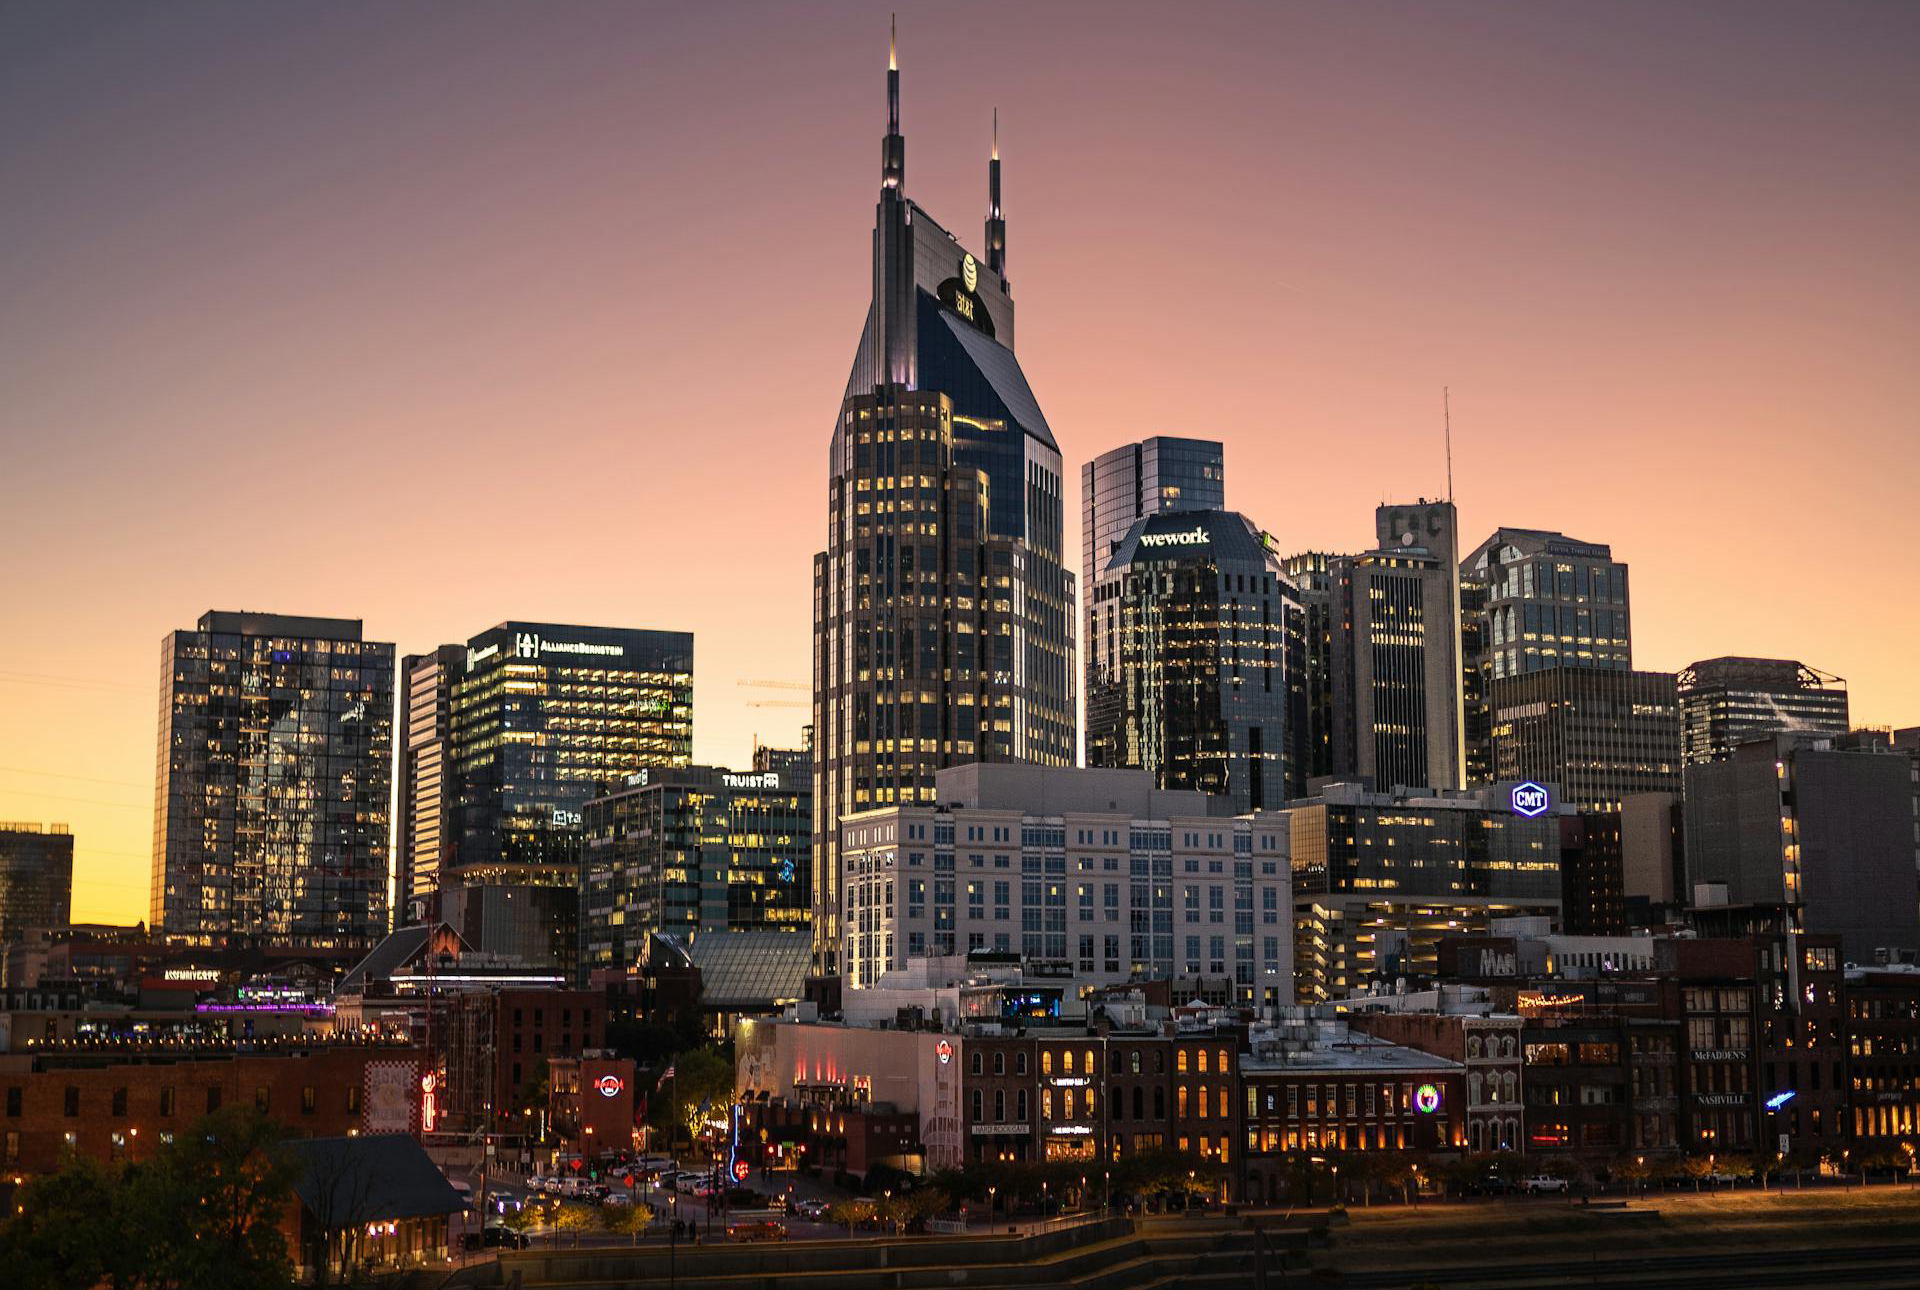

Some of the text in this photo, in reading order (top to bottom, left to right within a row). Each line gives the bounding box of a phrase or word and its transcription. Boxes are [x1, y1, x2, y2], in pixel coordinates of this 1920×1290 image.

[956, 290, 974, 321] at&t
[1140, 526, 1211, 548] wework
[722, 774, 763, 788] TRUIST
[1517, 791, 1543, 807] CMT
[1695, 1051, 1747, 1060] McFADDEN'S
[1698, 1095, 1745, 1105] NASHVILLE
